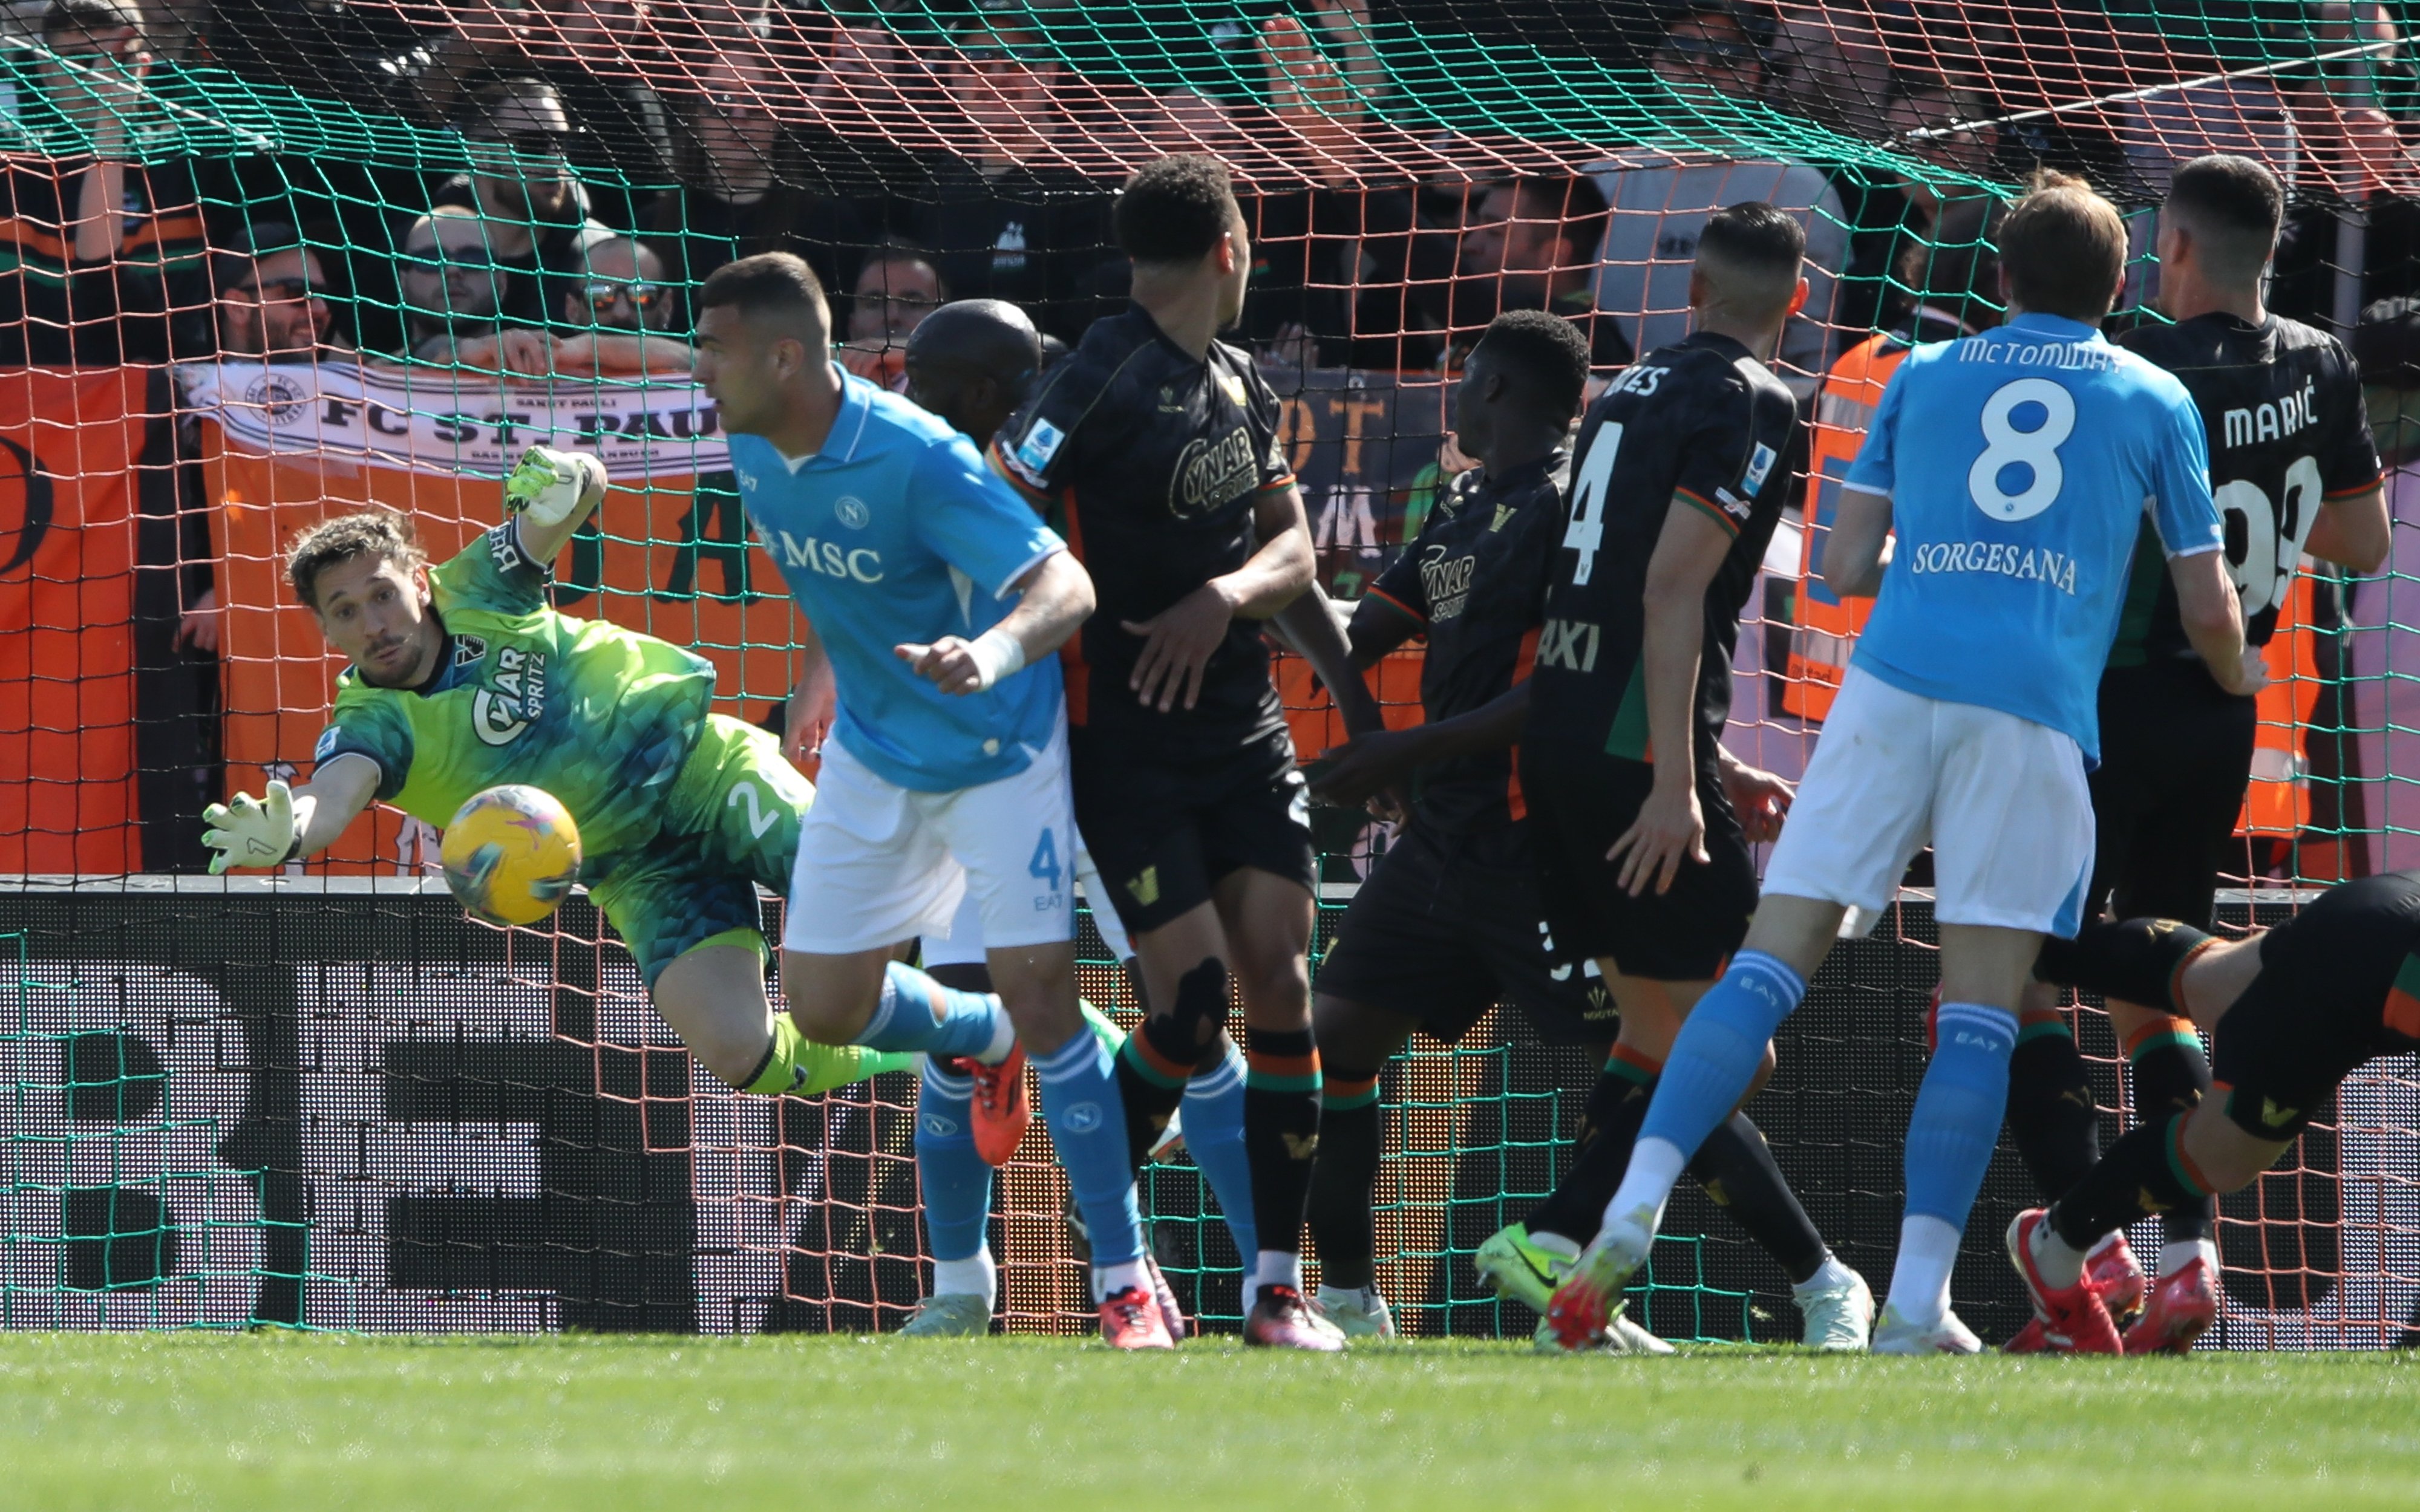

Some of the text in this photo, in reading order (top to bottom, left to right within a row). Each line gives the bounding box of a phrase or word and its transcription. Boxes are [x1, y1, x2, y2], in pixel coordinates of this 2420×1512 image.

[321, 392, 409, 435] FC
[434, 412, 551, 445] ST.
[573, 406, 719, 445] PAU
[2224, 374, 2318, 448] MARIĆ
[1969, 377, 2076, 523] 8
[1562, 421, 1624, 585] 4
[779, 530, 884, 584] MSC
[1912, 541, 2076, 596] SORGESANA
[527, 653, 545, 720] SPRITZ
[728, 781, 780, 839] 2
[1029, 827, 1061, 891] 4
[1035, 893, 1064, 911] EA7
